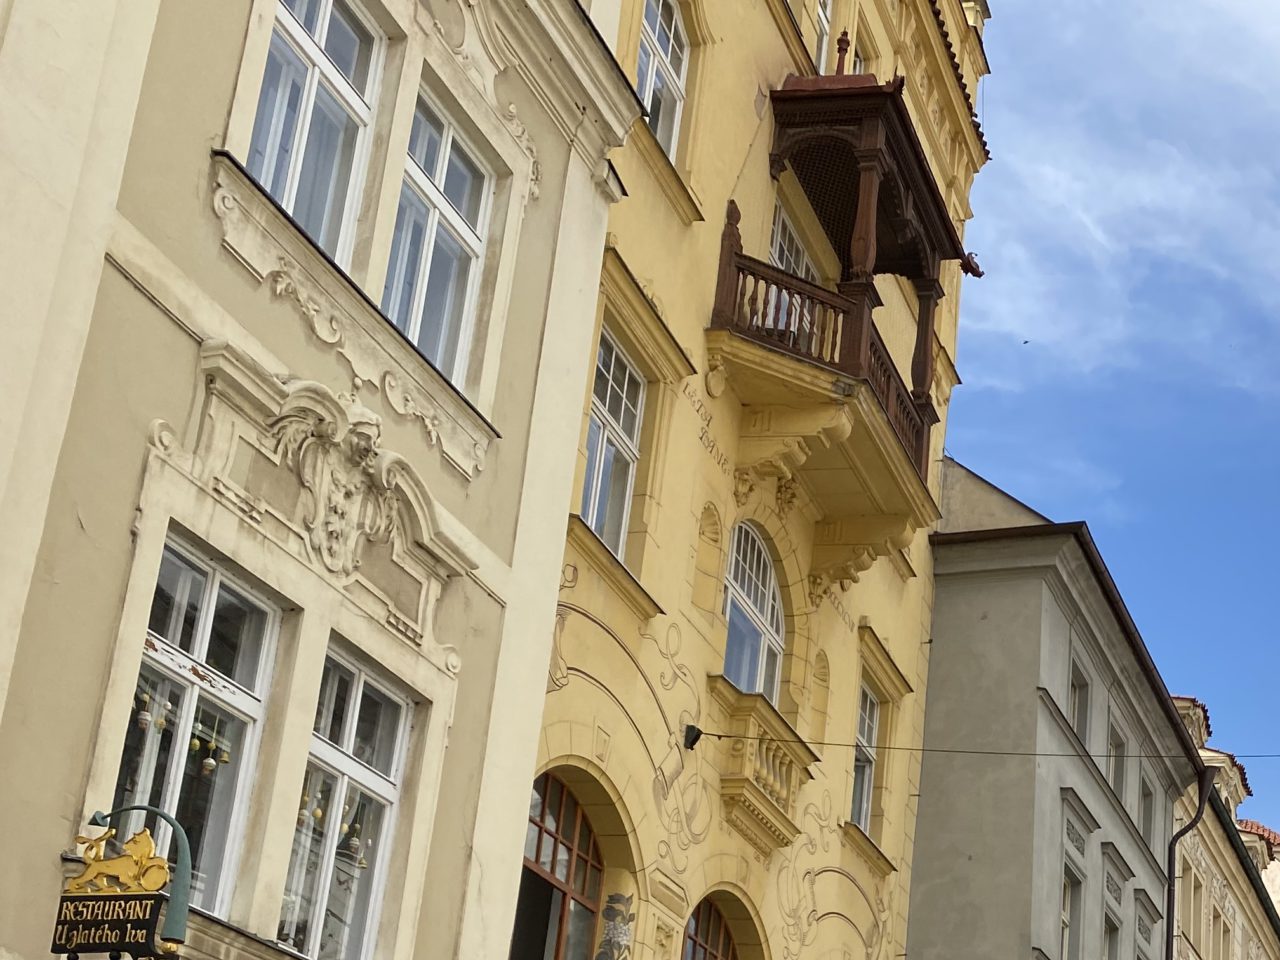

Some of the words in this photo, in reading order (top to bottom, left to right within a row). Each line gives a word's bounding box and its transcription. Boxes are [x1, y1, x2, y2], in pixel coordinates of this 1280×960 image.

[60, 899, 154, 921] RESTAURANT
[56, 924, 68, 944] U
[66, 923, 120, 950] zlatého
[125, 923, 147, 943] lva
